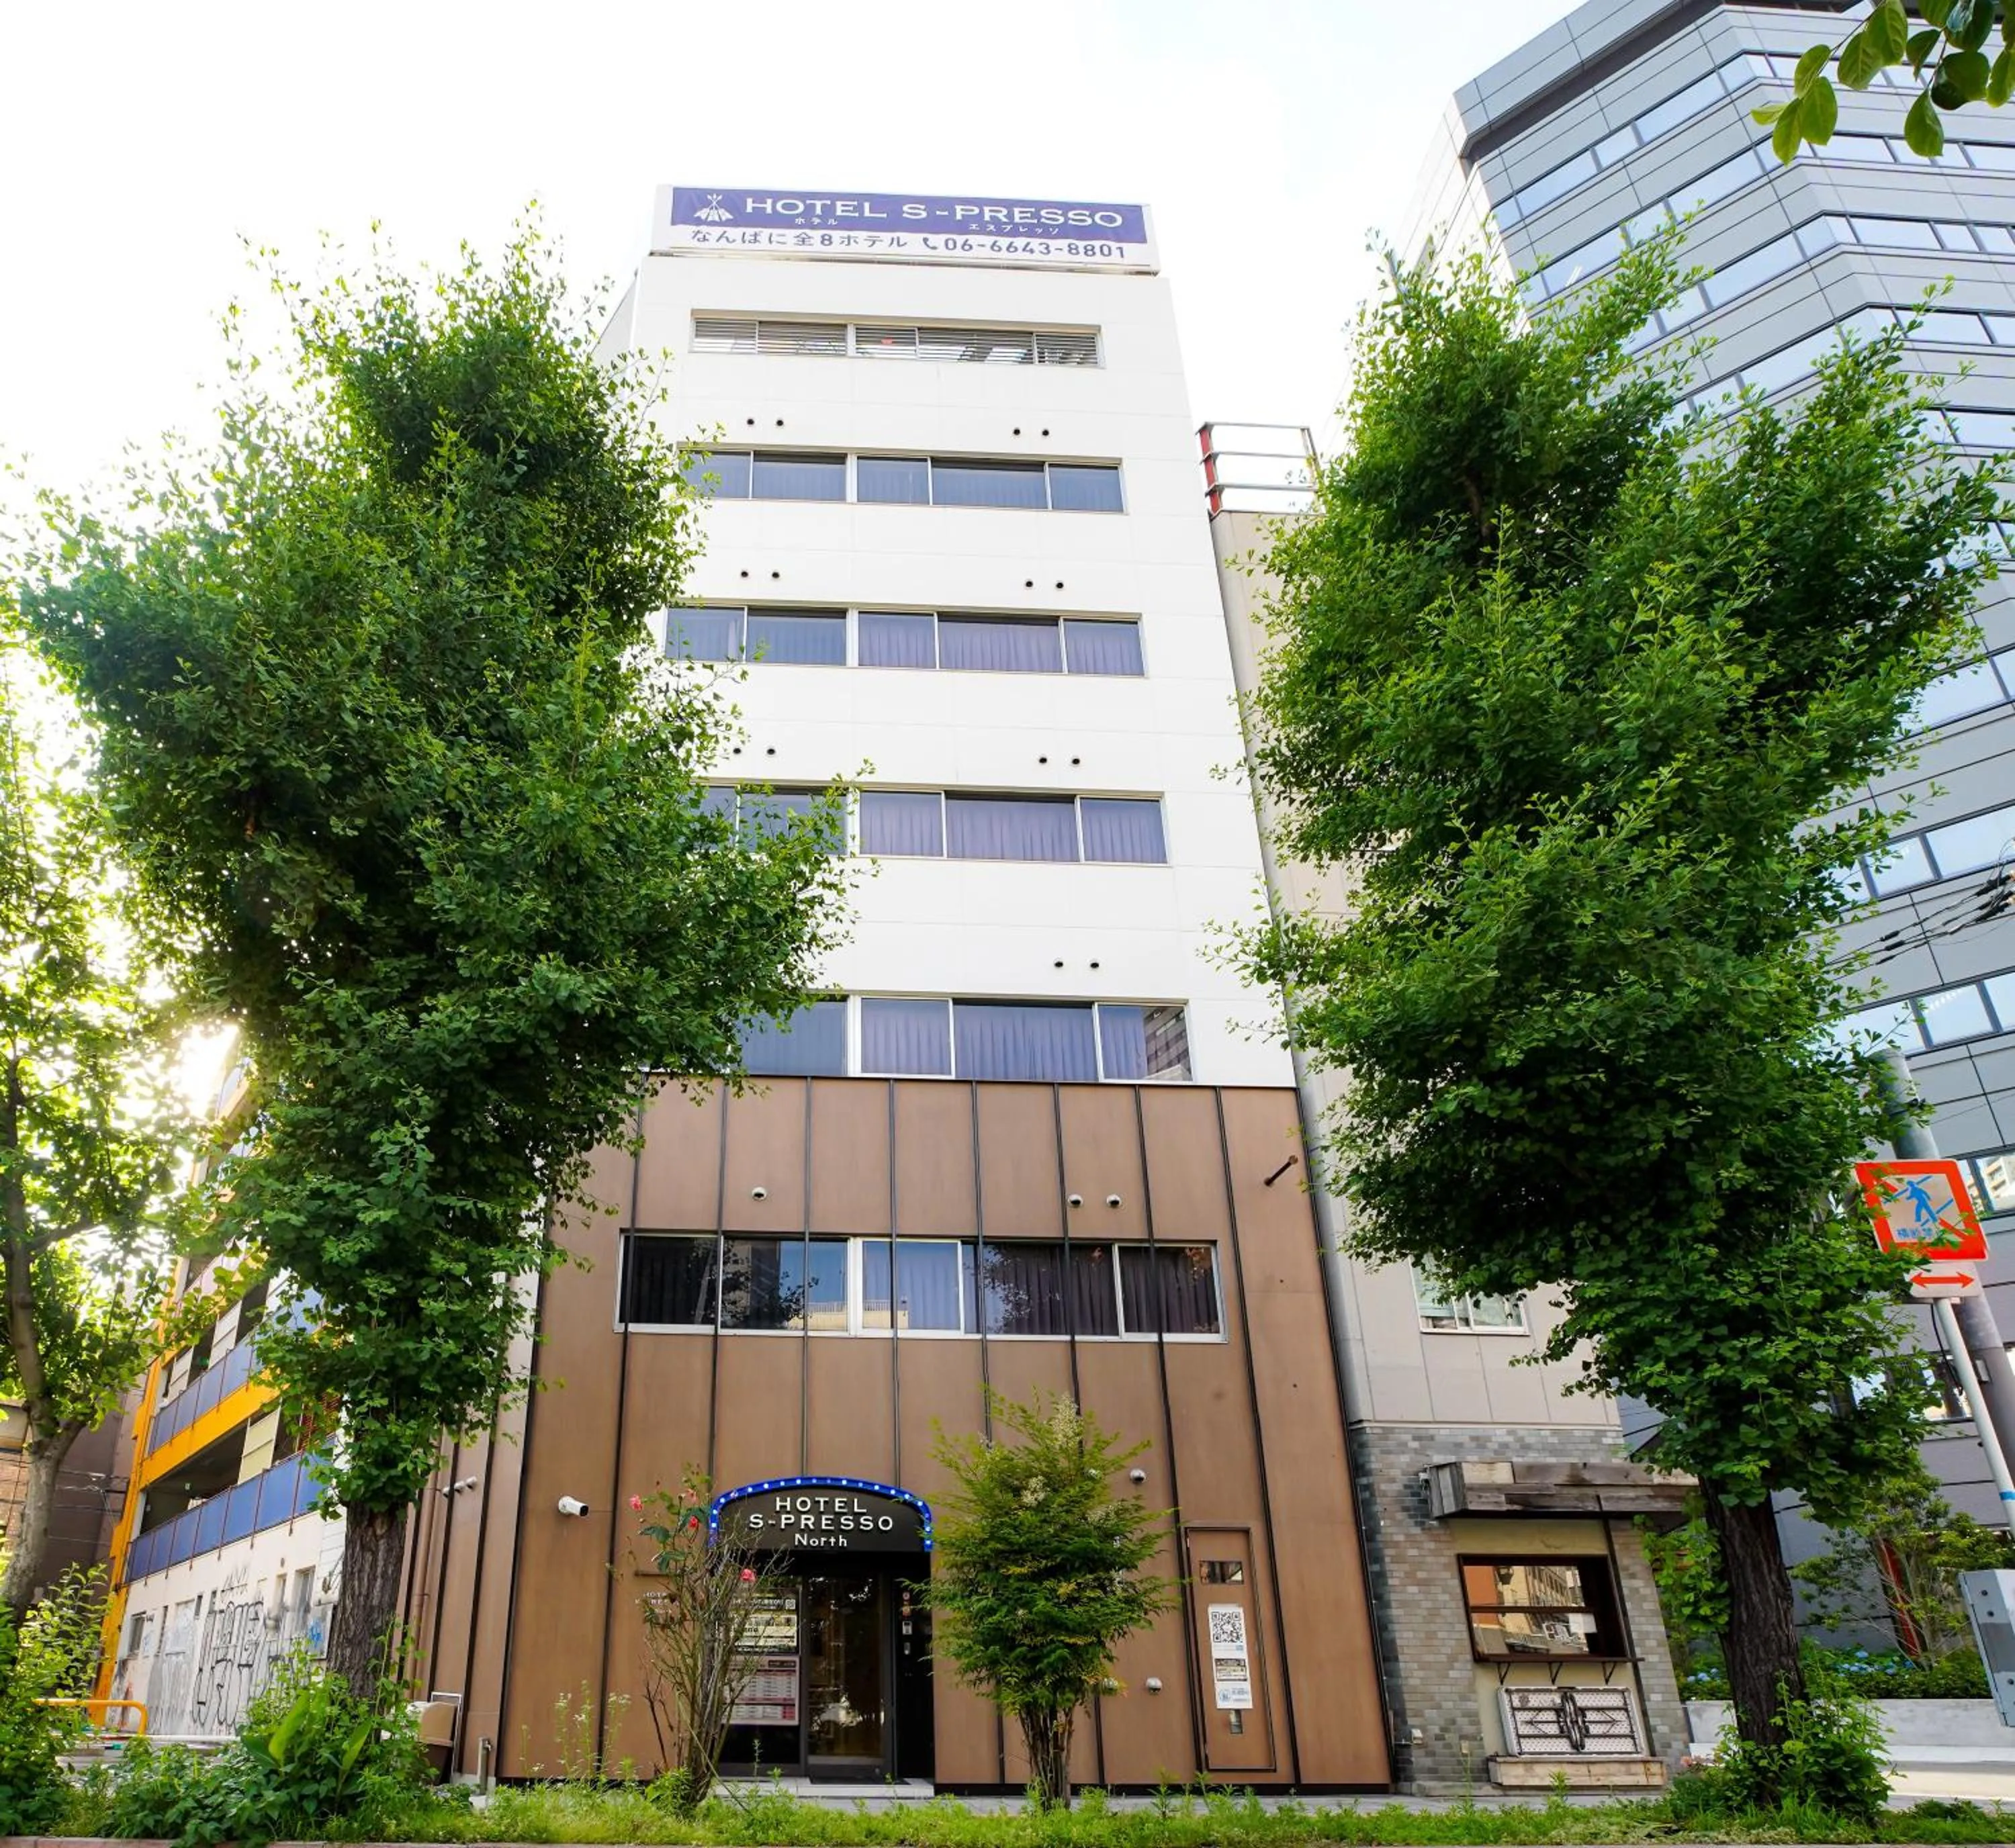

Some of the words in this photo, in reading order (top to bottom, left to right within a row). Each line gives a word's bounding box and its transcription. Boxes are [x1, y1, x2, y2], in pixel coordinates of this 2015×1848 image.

[746, 198, 887, 218] HOTEL
[902, 203, 1122, 228] S-PRESSO
[795, 217, 839, 226] ホテル
[969, 223, 1059, 234] エスプレッソ
[692, 230, 907, 248] なんばに全8ホテル
[944, 238, 1125, 259] 06-6643-8801
[775, 1497, 867, 1512] HOTEL
[749, 1514, 893, 1530] S-PRESSO
[795, 1533, 848, 1547] North
